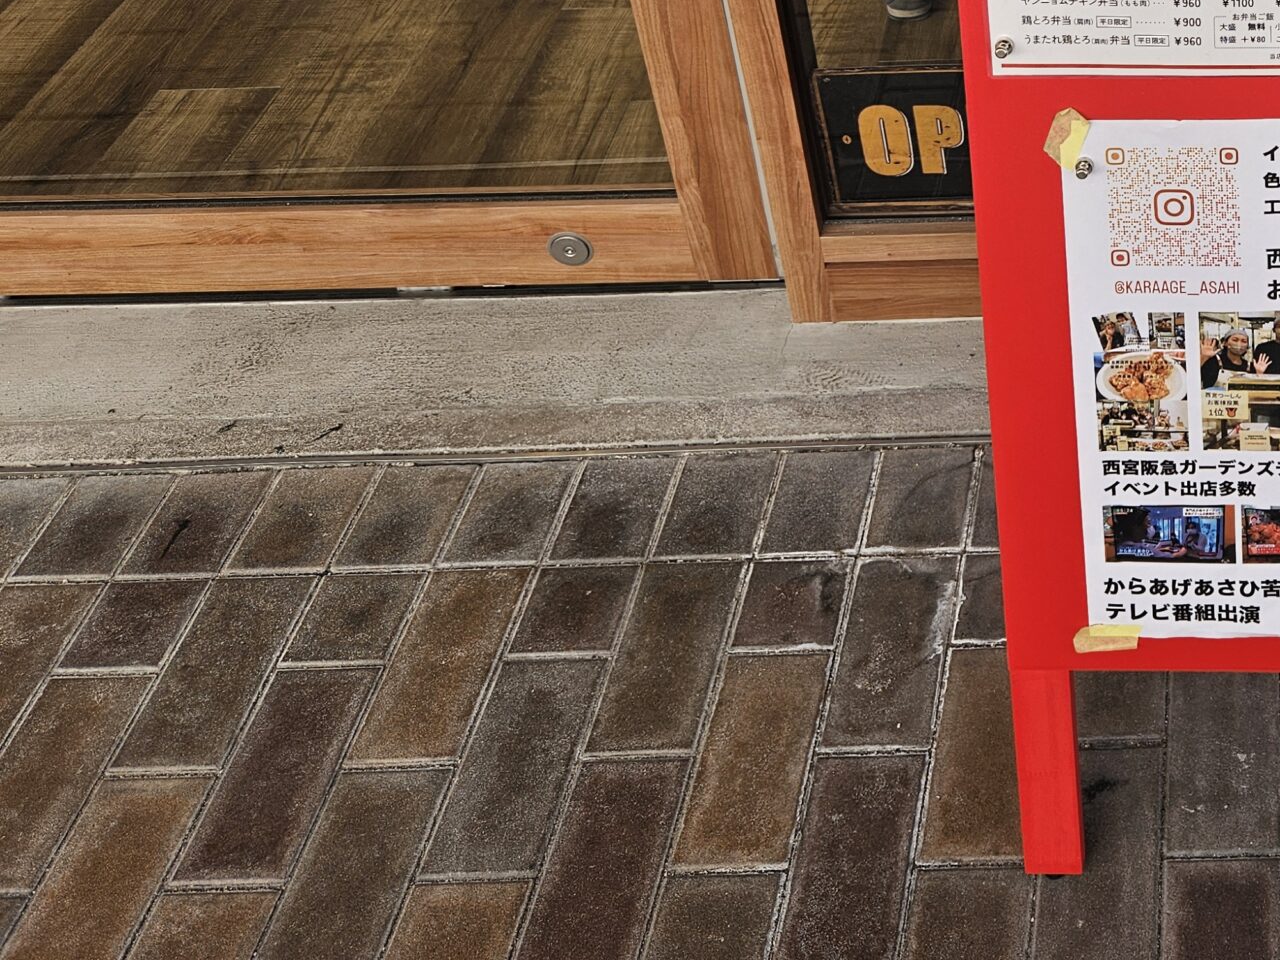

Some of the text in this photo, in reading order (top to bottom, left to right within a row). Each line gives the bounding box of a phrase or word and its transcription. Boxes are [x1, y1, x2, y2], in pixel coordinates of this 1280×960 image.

[1173, 17, 1202, 28] ¥900
[1232, 12, 1275, 22] お弁当ご飯
[1219, 23, 1237, 32] 大盛
[1174, 36, 1202, 47] ¥960
[1103, 481, 1257, 498] イベント出店多数
[1105, 604, 1262, 625] テレビ番組出演
